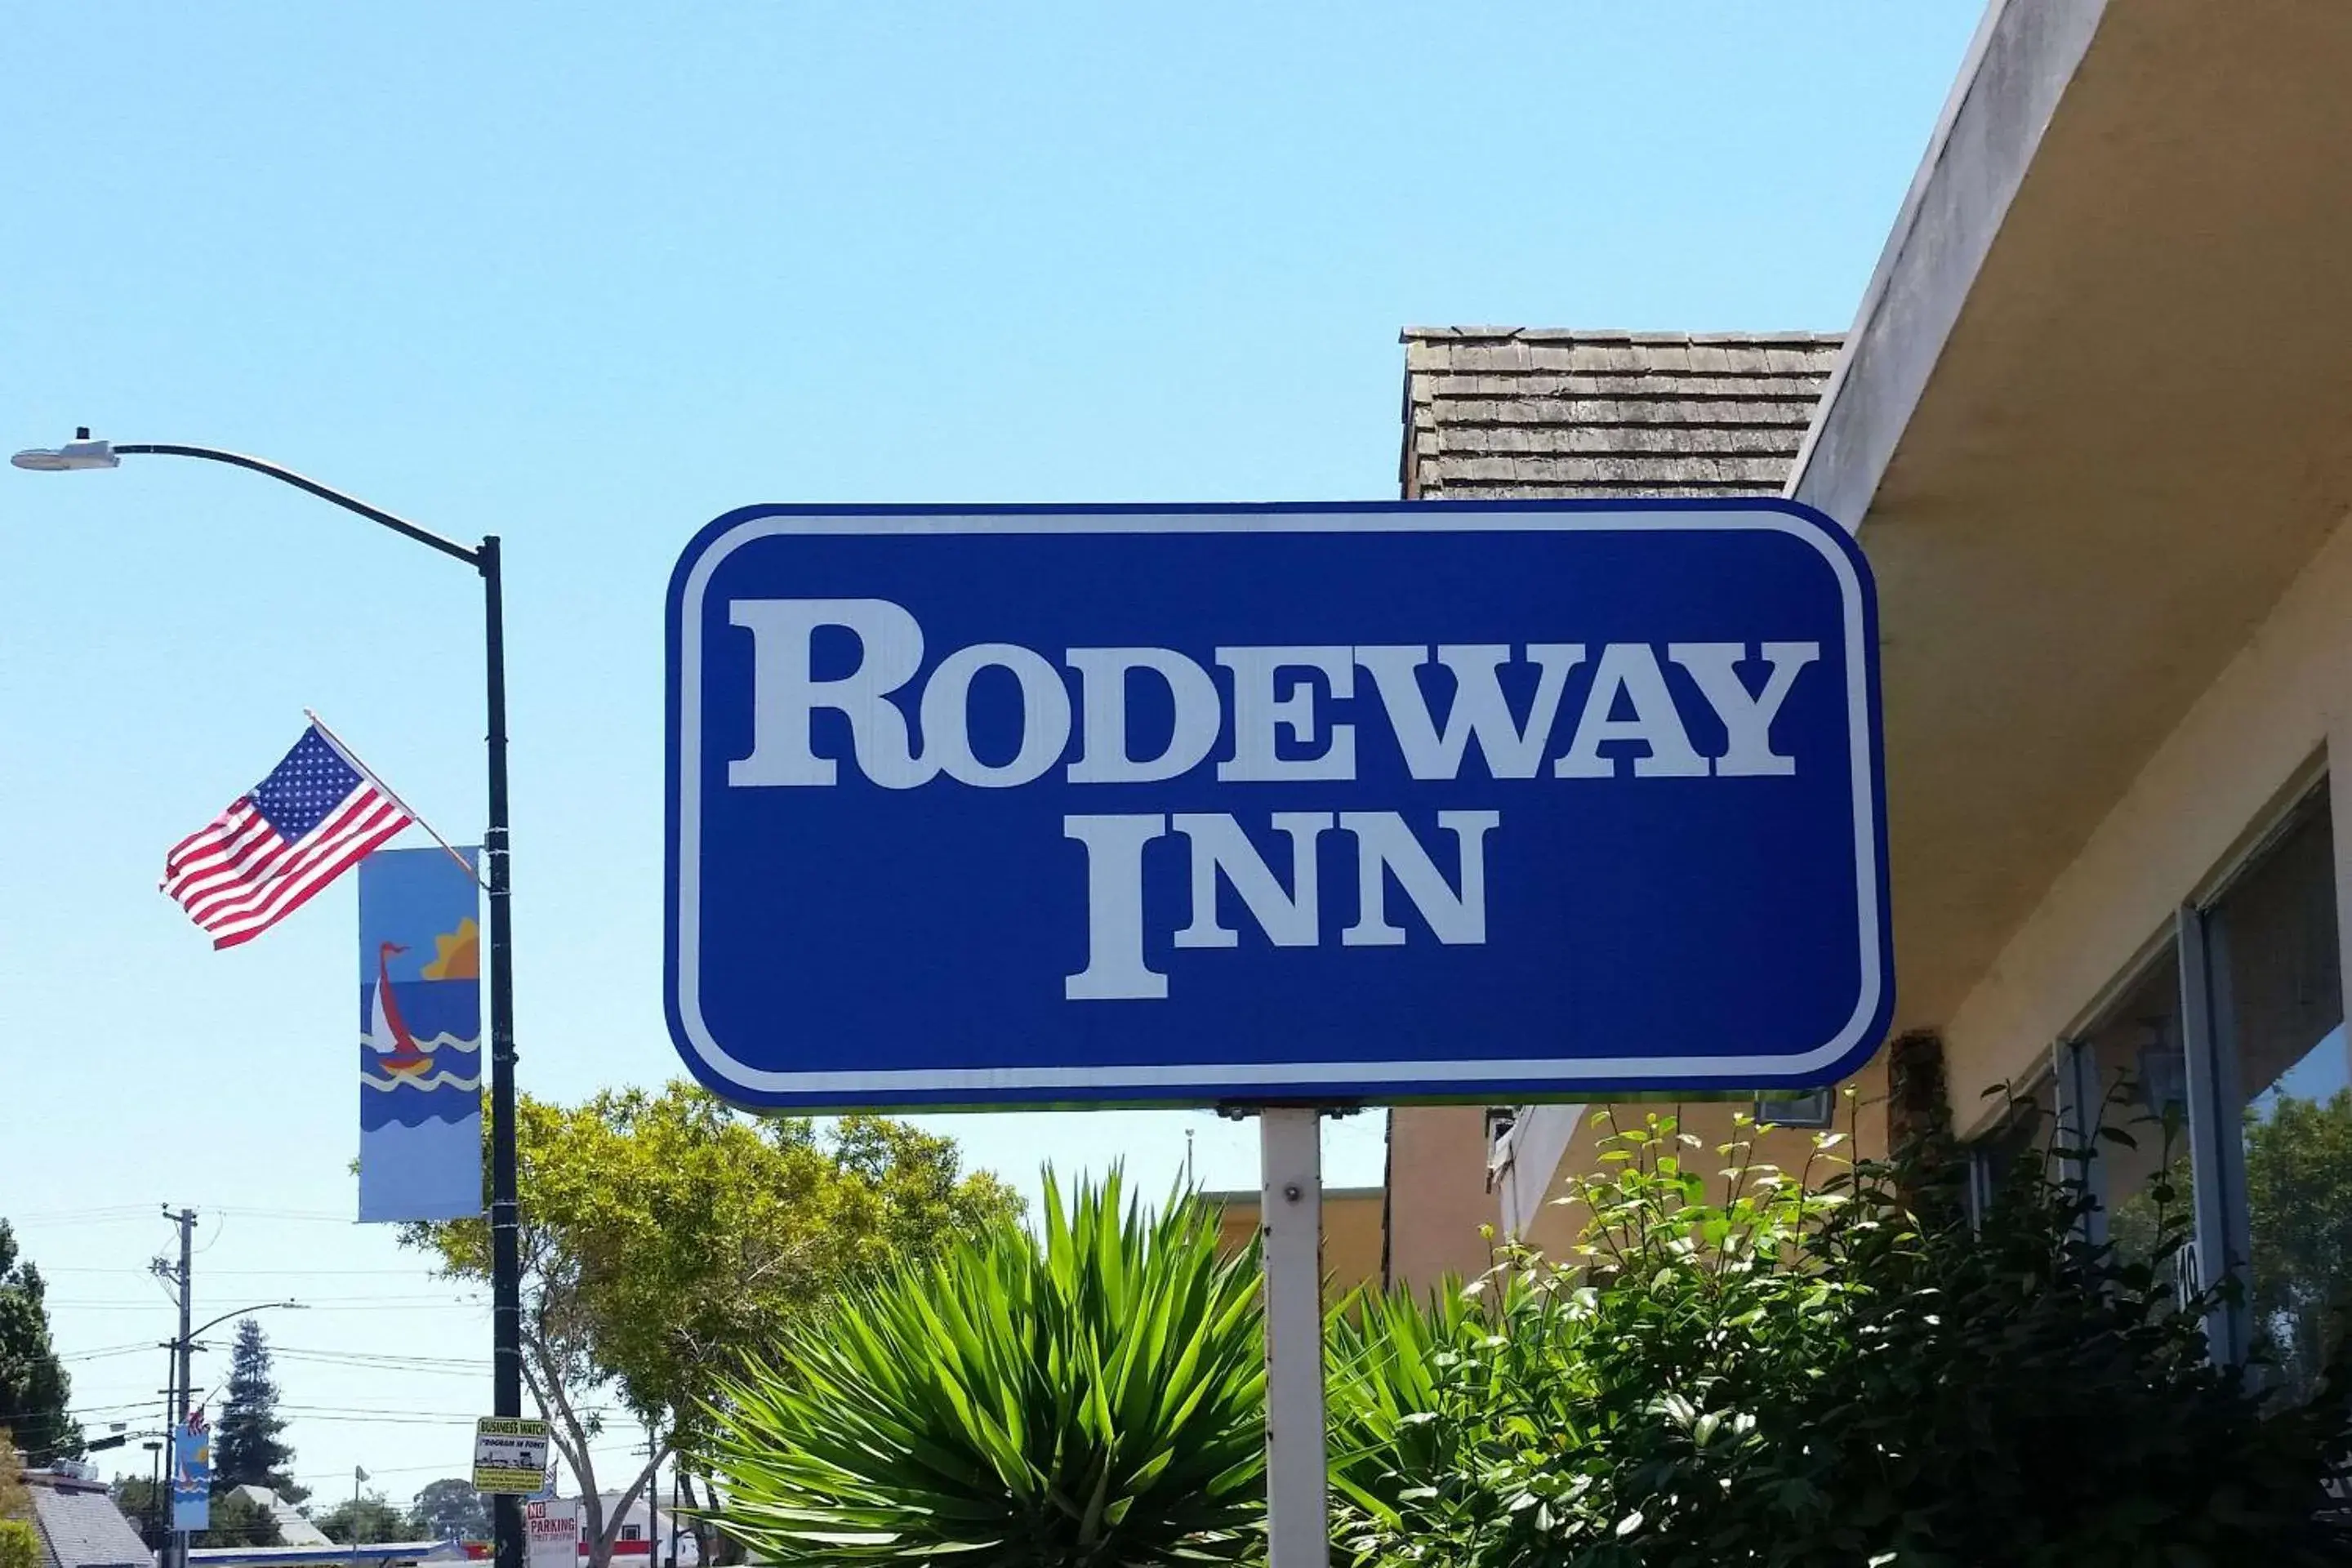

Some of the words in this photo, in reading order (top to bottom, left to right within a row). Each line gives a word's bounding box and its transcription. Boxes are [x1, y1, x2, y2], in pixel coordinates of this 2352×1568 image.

[728, 599, 1820, 789] RODEWAY
[1064, 810, 1499, 1000] INN
[481, 1422, 518, 1433] BUSINESS
[520, 1423, 546, 1435] WATCH
[529, 1503, 544, 1517] NO
[532, 1518, 574, 1533] PARKING
